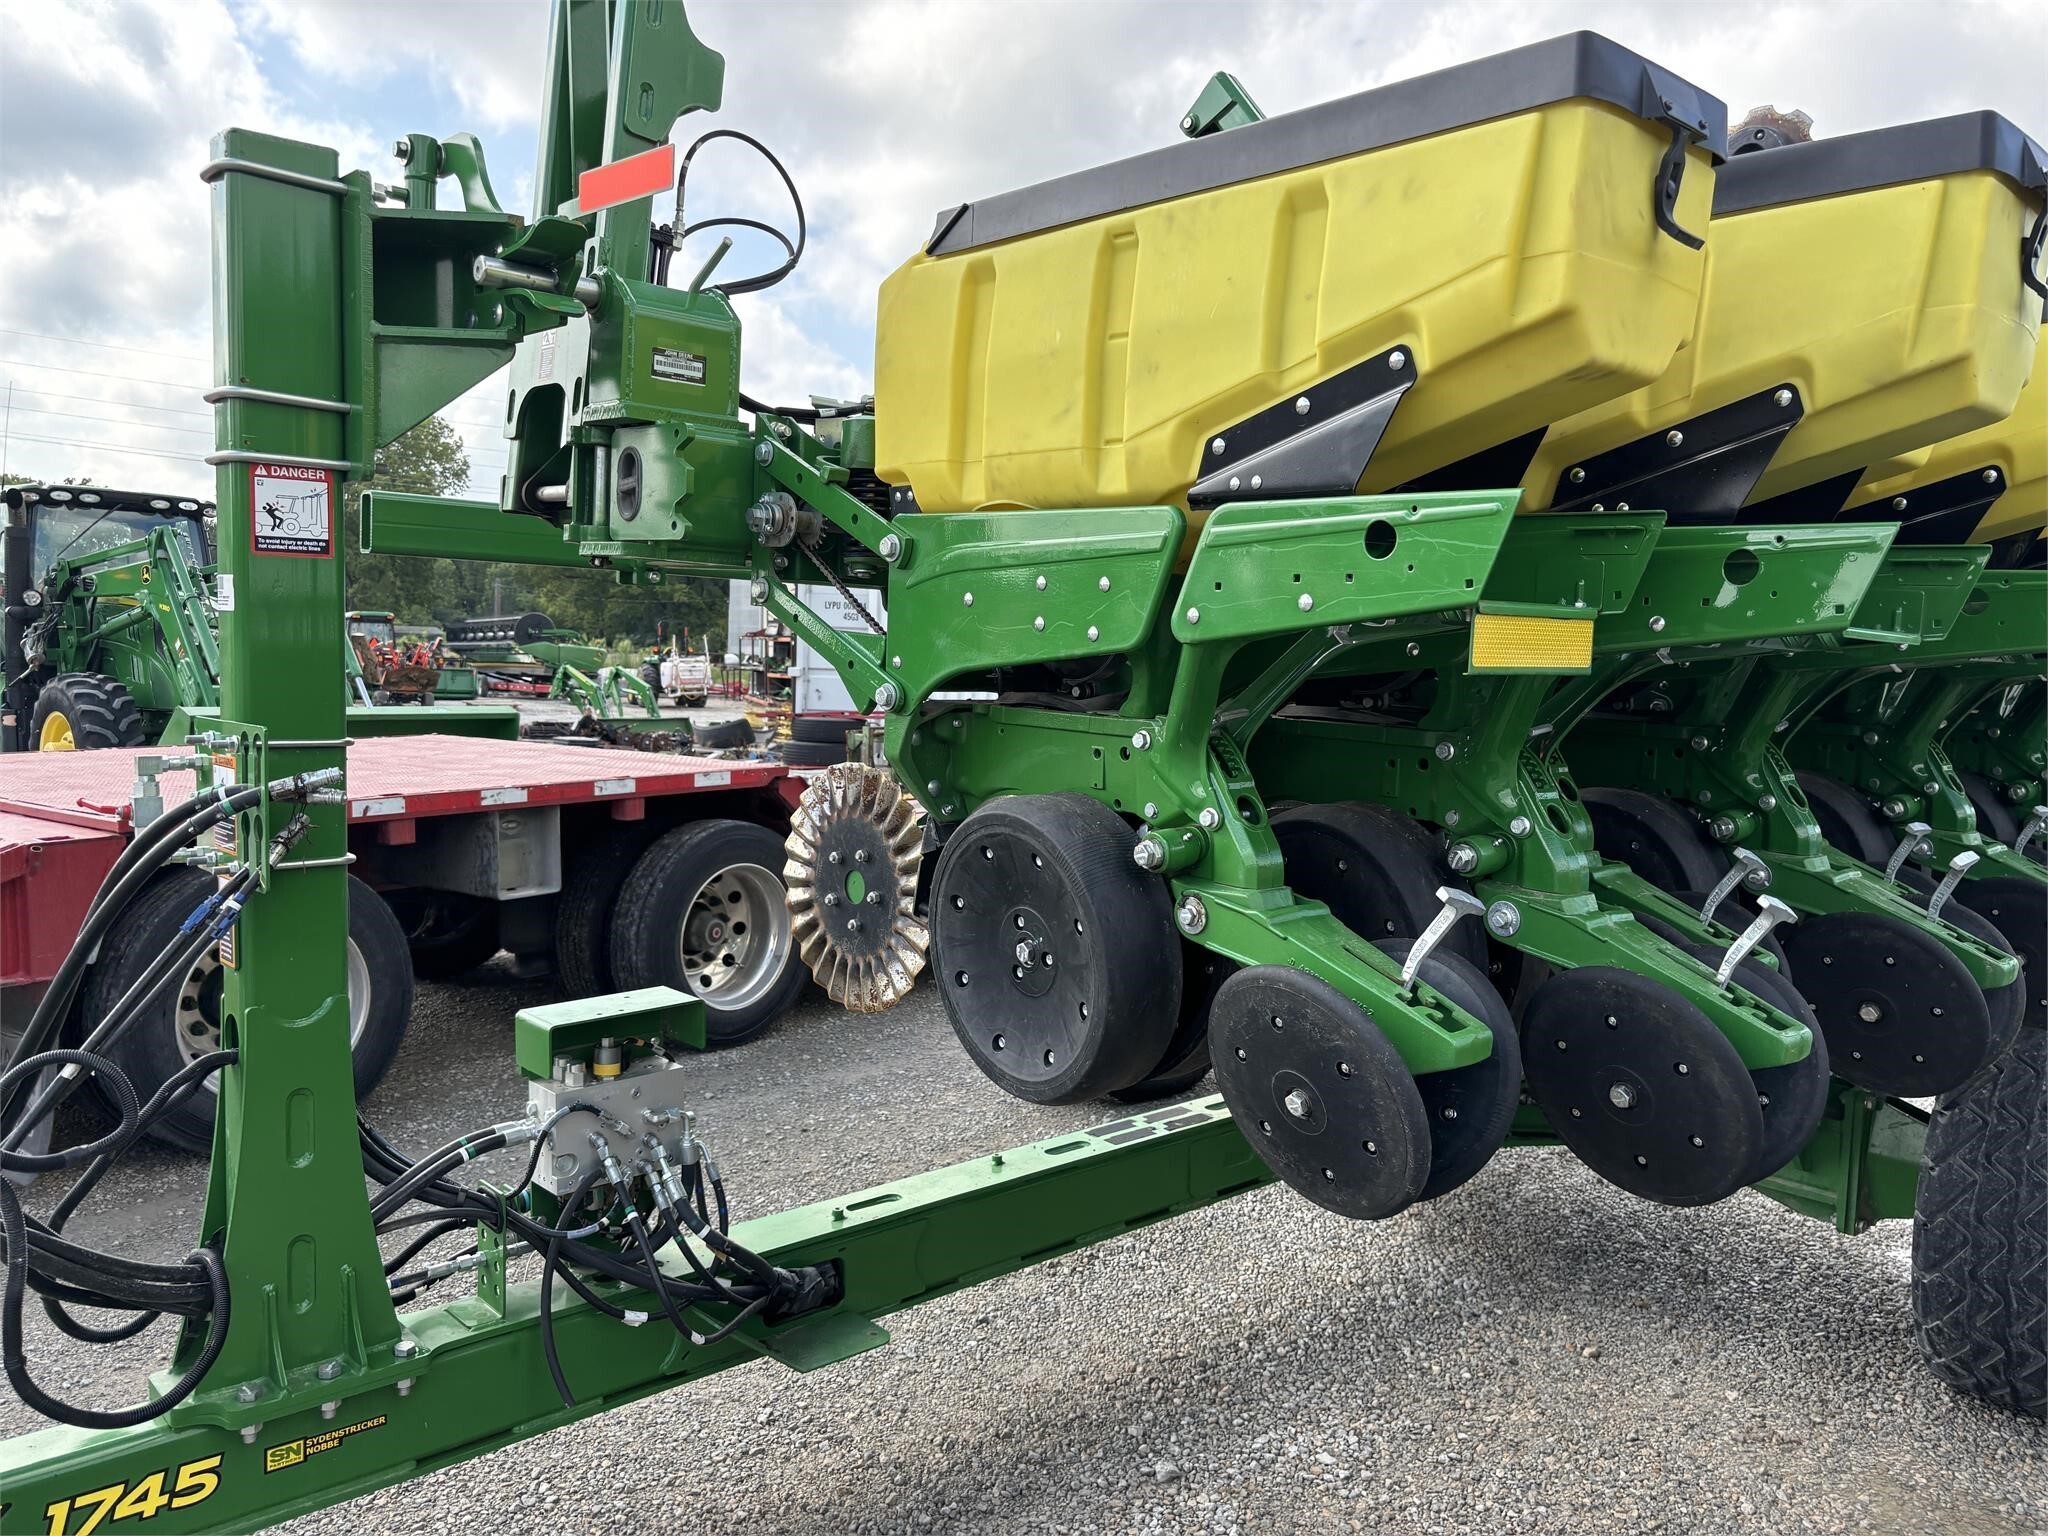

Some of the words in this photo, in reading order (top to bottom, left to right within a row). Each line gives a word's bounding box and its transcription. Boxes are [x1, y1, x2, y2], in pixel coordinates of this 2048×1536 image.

[271, 466, 325, 479] DANGER
[824, 601, 841, 610] LYPU
[305, 1415, 386, 1447] SYDENSTRICKER
[269, 1442, 302, 1463] SN
[306, 1438, 340, 1455] NOBBE
[46, 1454, 222, 1536] 1745
